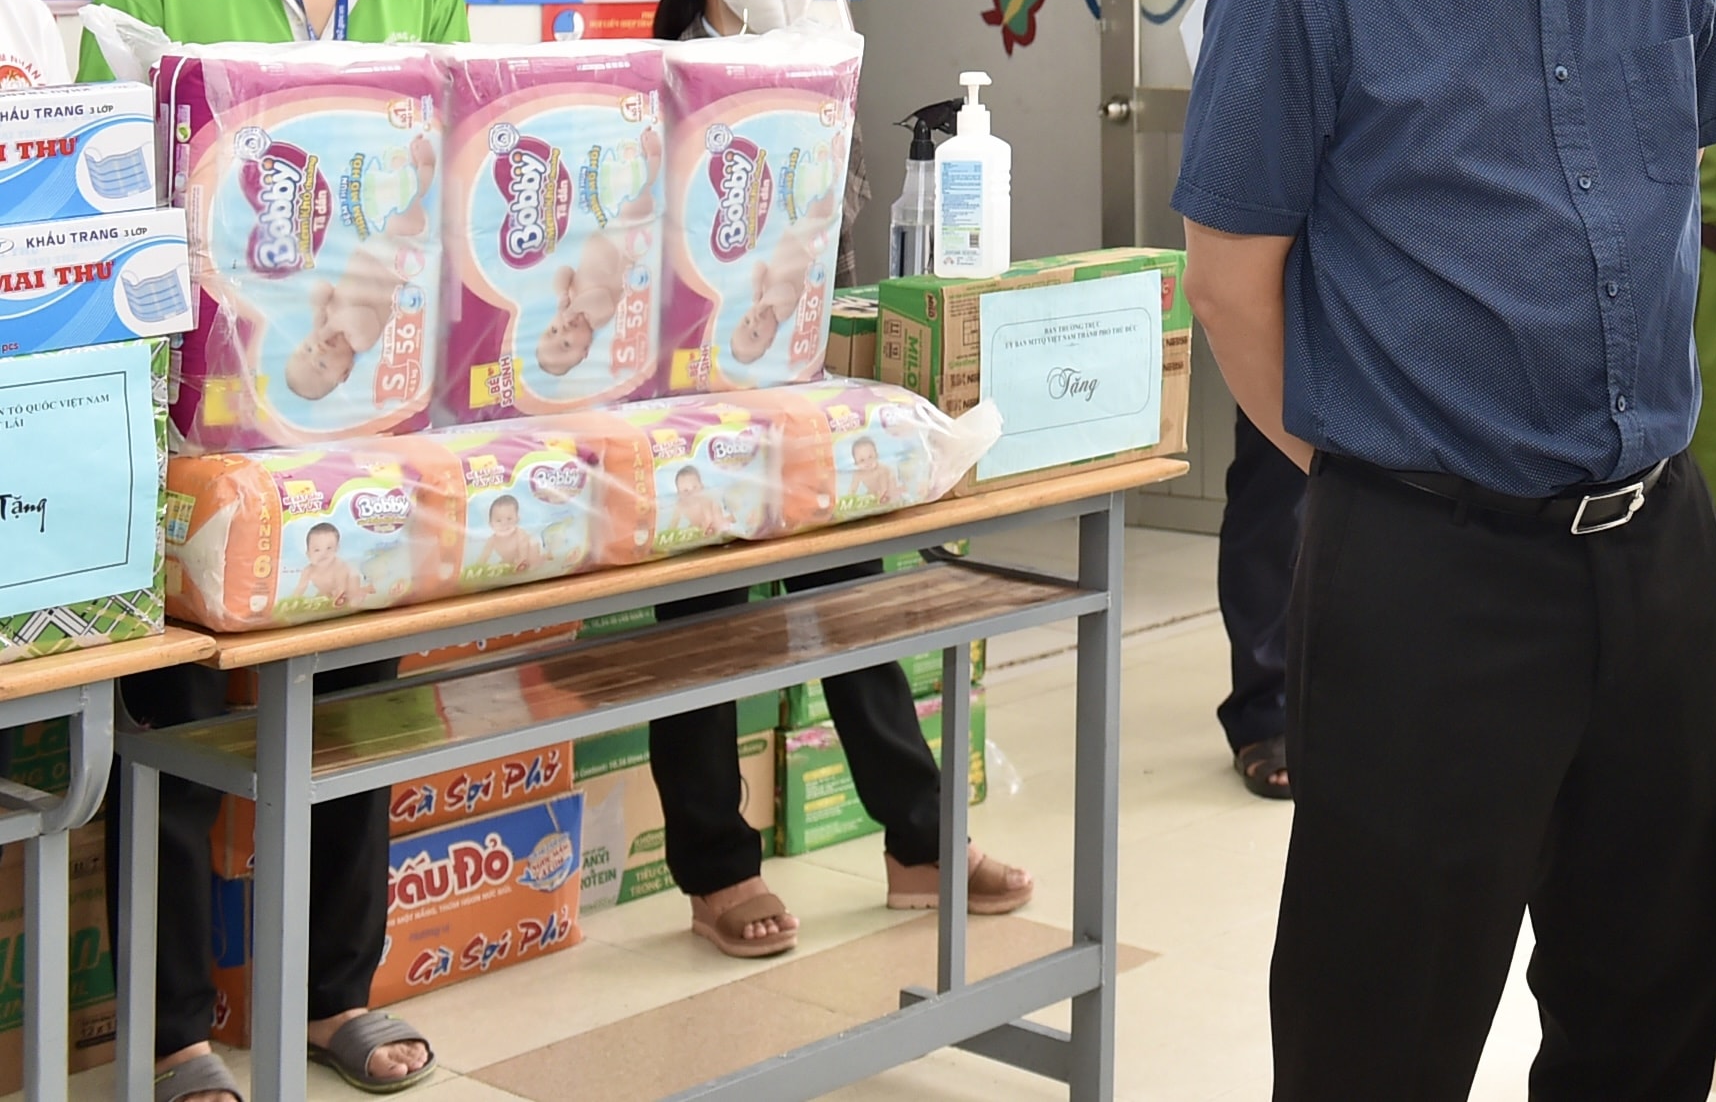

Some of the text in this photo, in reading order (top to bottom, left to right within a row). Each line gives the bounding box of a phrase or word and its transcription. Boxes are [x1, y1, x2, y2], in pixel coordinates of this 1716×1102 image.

[34, 105, 84, 119] TRANG
[89, 107, 95, 115] 3
[97, 105, 114, 114] LỚP
[17, 137, 79, 159] THƯ
[259, 157, 302, 268] Bobby
[314, 190, 328, 232] Tã dán
[509, 151, 547, 256] Bobby
[718, 150, 754, 249] Bobby
[70, 228, 118, 243] TRANG
[124, 229, 129, 237] 3
[131, 226, 148, 236] LỚP
[54, 259, 115, 285] THƯ
[627, 300, 644, 329] 56
[805, 295, 819, 322] 56
[396, 323, 416, 354] 56
[794, 340, 808, 355] S
[617, 348, 636, 363] S
[907, 335, 919, 388] MILO
[382, 373, 405, 391] S
[489, 377, 500, 394] BÉ
[501, 357, 512, 388] SINH
[1047, 367, 1099, 402] Tặng
[25, 400, 58, 414] QUỐC
[60, 396, 84, 409] VIỆT
[86, 394, 110, 406] NAM
[5, 418, 24, 429] LÁI
[535, 468, 579, 489] Bobby
[0, 494, 47, 533] Tặng
[359, 495, 409, 517] Bobby
[253, 555, 272, 578] 6
[389, 750, 562, 820] Gà Sợi Phở
[388, 833, 513, 915] ấu Đỏ
[581, 869, 617, 890] OTEIN
[407, 905, 571, 984] Gà Sợi Phở
